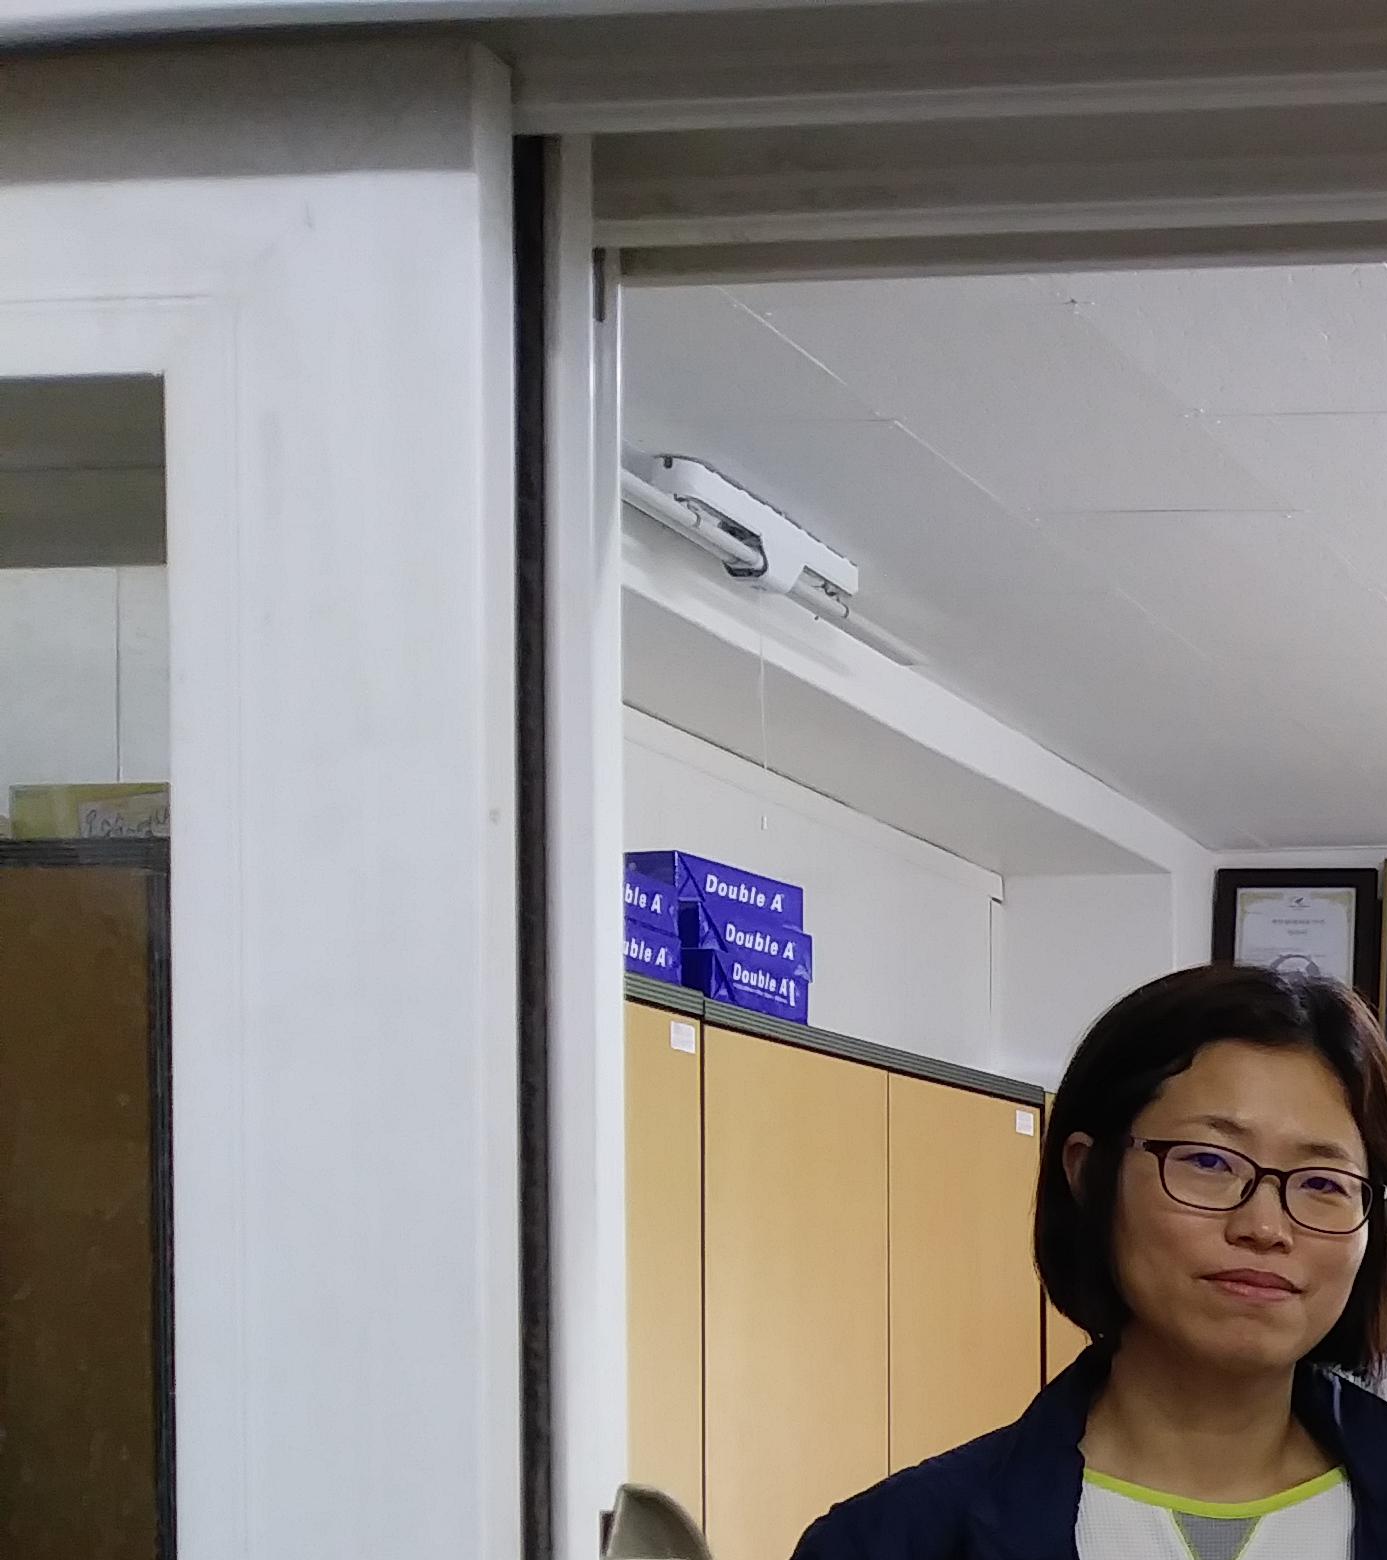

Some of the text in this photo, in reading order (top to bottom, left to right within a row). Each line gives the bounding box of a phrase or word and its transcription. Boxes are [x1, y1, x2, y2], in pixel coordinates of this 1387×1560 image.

[650, 893, 663, 914] A
[705, 873, 784, 913] Double A
[655, 946, 668, 968] A
[725, 923, 796, 961] Double A
[732, 962, 777, 992] Double
